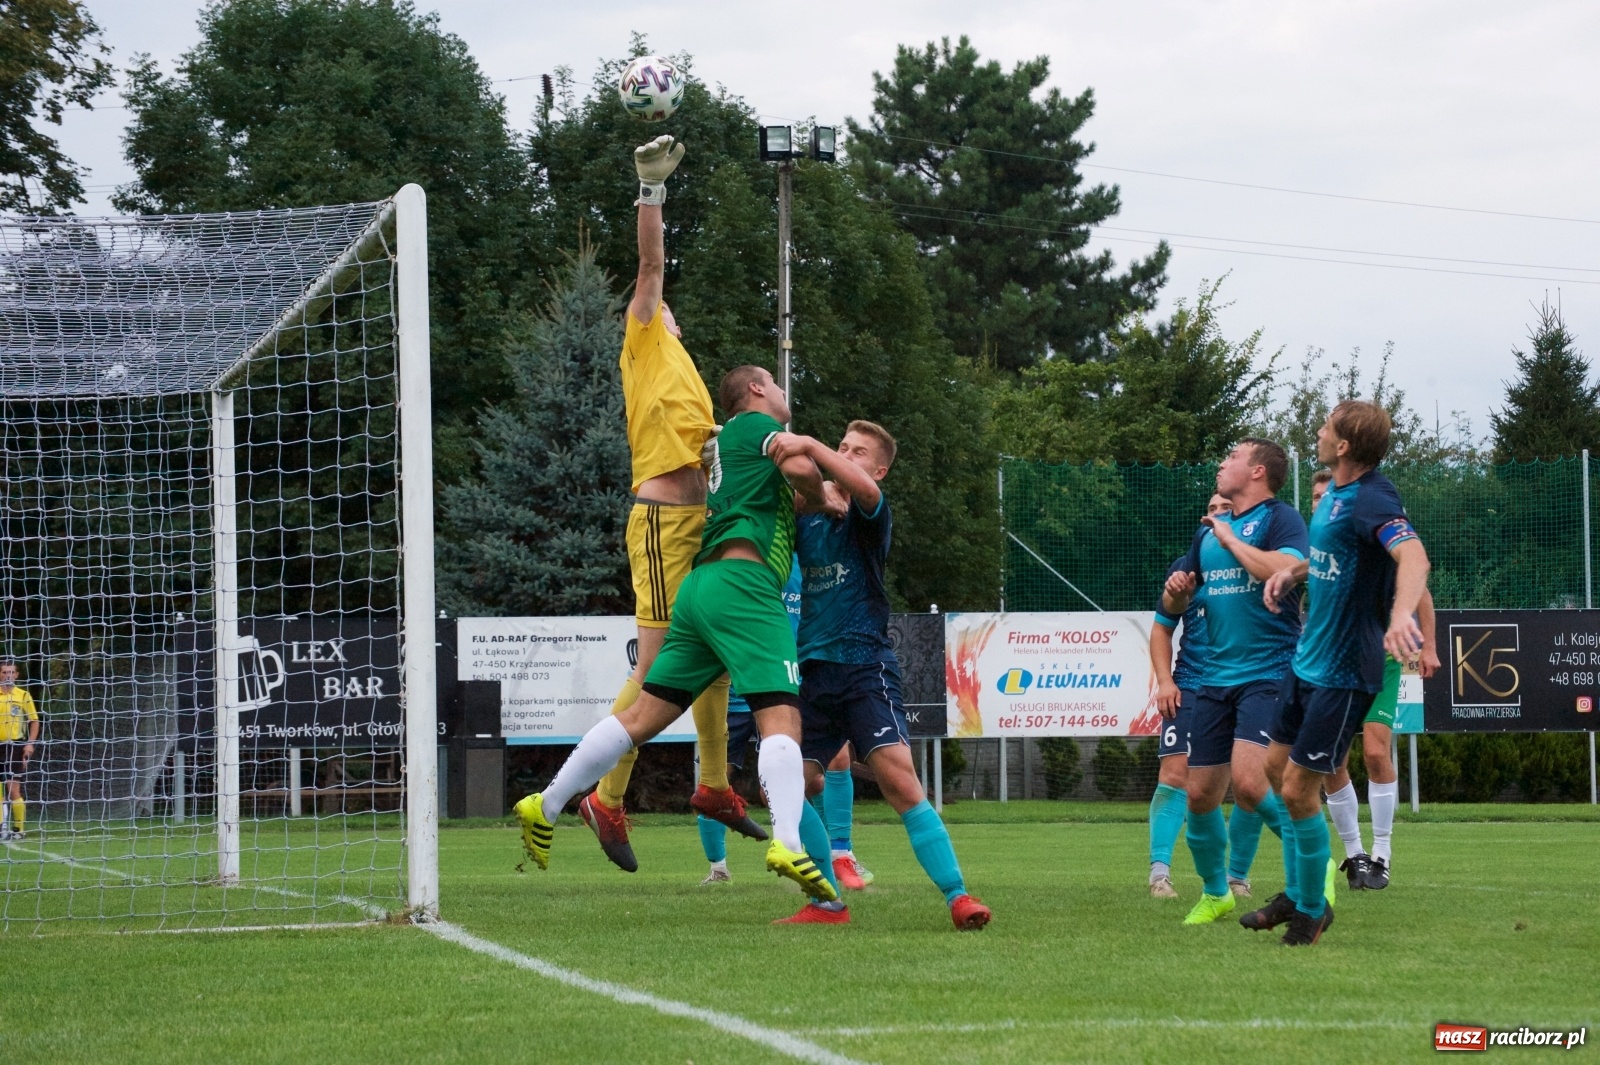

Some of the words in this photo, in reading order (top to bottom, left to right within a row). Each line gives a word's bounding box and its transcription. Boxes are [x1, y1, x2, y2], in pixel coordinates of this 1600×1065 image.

[1210, 567, 1243, 581] SPORT
[1208, 584, 1245, 596] Racibórz
[472, 635, 488, 643] F.U.
[491, 635, 528, 643] AD-RAF
[530, 635, 573, 645] Grzegorz
[575, 634, 607, 643] Nowak
[1008, 631, 1050, 644] Firma
[1554, 632, 1567, 646] ul.
[1571, 632, 1600, 649] Kolej
[291, 641, 348, 663] LEX
[472, 648, 483, 656] ul.
[485, 648, 520, 657] Łąkowa
[1014, 647, 1039, 655] Helena
[1044, 647, 1084, 655] Aleksander
[1085, 646, 1112, 654] Michna
[472, 660, 507, 668] 47-450
[509, 660, 571, 670] Krzyżanowice
[1456, 630, 1519, 697] K5
[1549, 652, 1586, 665] 47-450
[489, 673, 508, 681] 504
[510, 673, 529, 681] 498
[532, 672, 550, 680] 073
[1036, 672, 1122, 688] LEWIATAN
[1549, 672, 1570, 686] +48
[1573, 671, 1594, 686] 698
[322, 676, 384, 699] BAR
[509, 697, 554, 707] koparkami
[557, 697, 617, 707] gąsienicowy
[1010, 702, 1045, 712] USŁUGI
[1047, 702, 1106, 712] BRUKARSKIE
[514, 710, 555, 719] ogrodzeń
[1486, 707, 1521, 718] FRYZJERSKA
[524, 723, 553, 731] terenu
[998, 715, 1021, 728] tel:
[1025, 714, 1118, 728] 507-144-696
[238, 725, 261, 738] 451
[367, 721, 402, 737] Głów
[1164, 725, 1177, 747] 6
